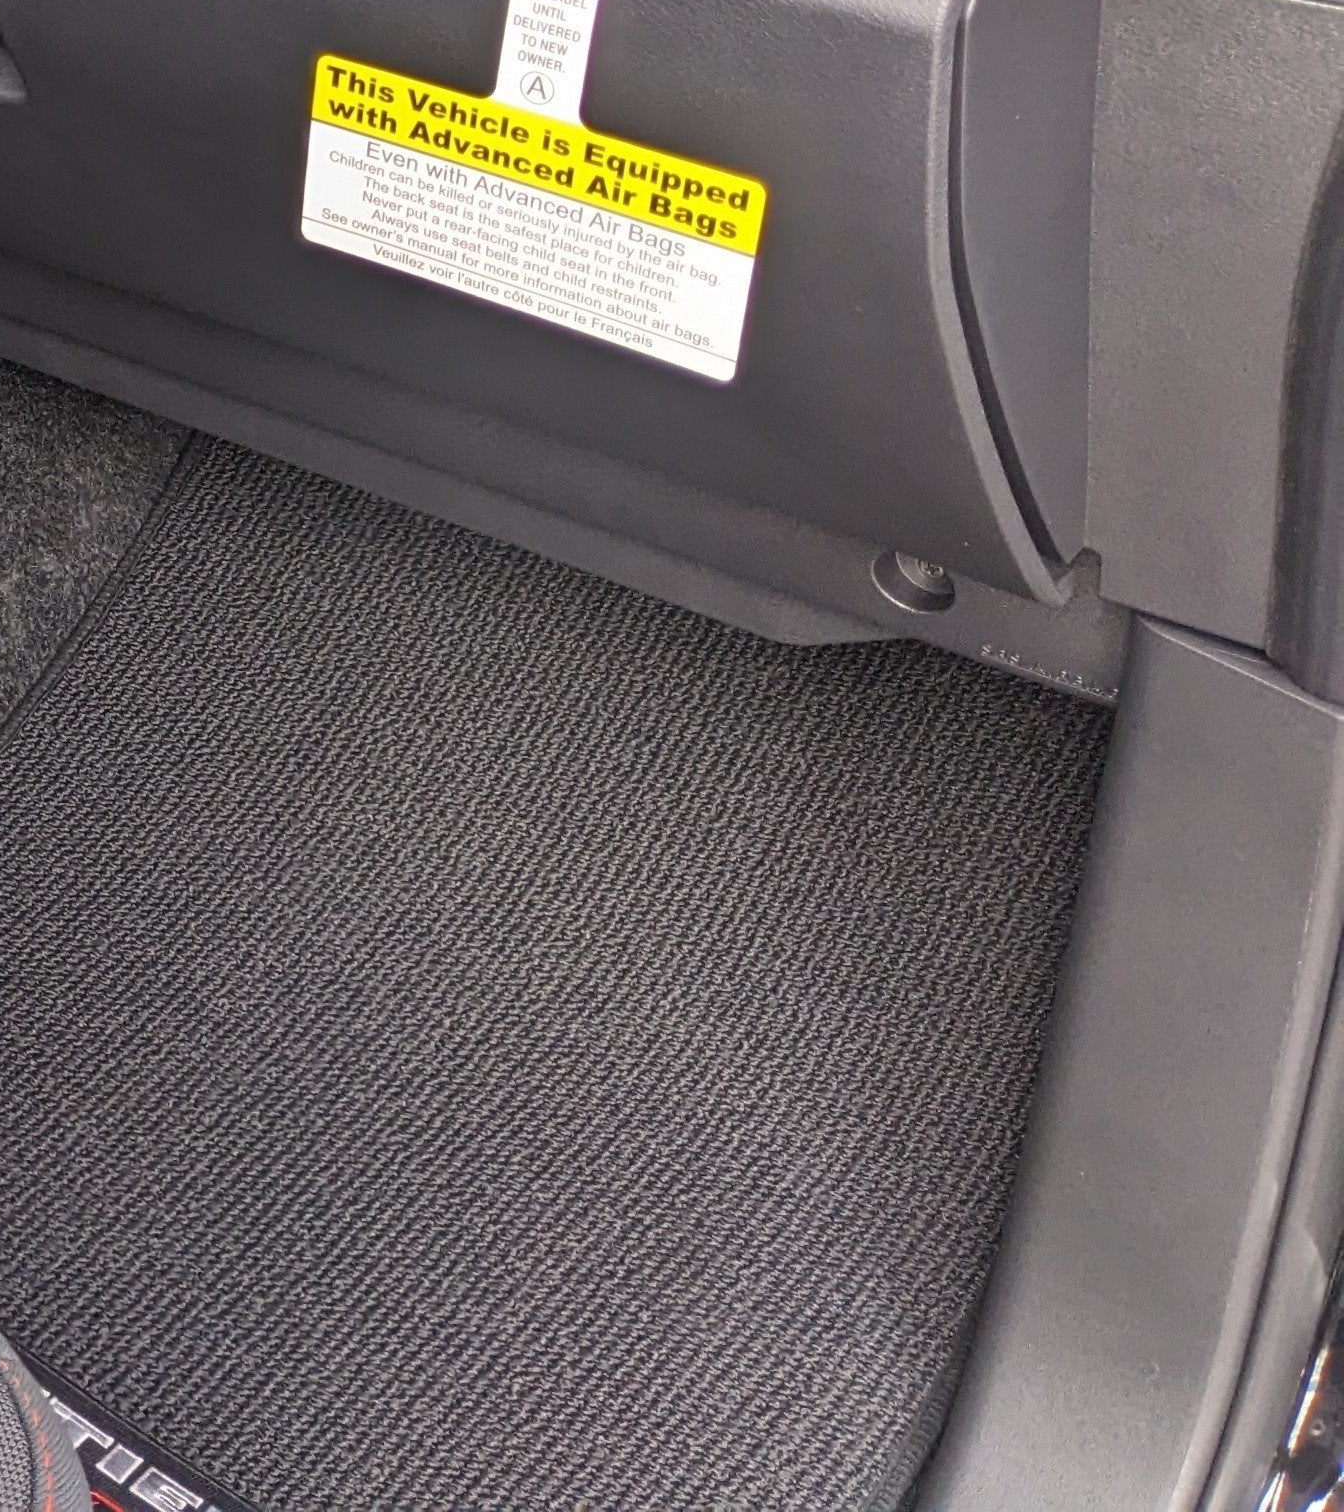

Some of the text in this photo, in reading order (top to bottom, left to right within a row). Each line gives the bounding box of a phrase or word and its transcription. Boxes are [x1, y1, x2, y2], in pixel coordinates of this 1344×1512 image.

[513, 14, 581, 43] DELIVERED
[517, 50, 566, 74] OWNER.
[521, 33, 569, 56] TO NEW
[532, 2, 566, 22] UNTIL
[326, 65, 750, 212] This Vehicle is Equipped
[328, 99, 738, 239] with Advanced Air Bags
[329, 150, 722, 287] Children can be killed or seriously injured by the air bag.
[362, 190, 676, 304] Never put a rear-facing child seat in the front.
[363, 175, 679, 288] The back seat is the safest place for children.
[366, 141, 687, 258] Even with Advanced Air Bags
[321, 207, 714, 349] See owner's manual for more information about air bags.
[371, 209, 662, 314] Always use seat belts and child restraints.
[373, 244, 653, 349] Veuillez voir l'autre côté pour le Français
